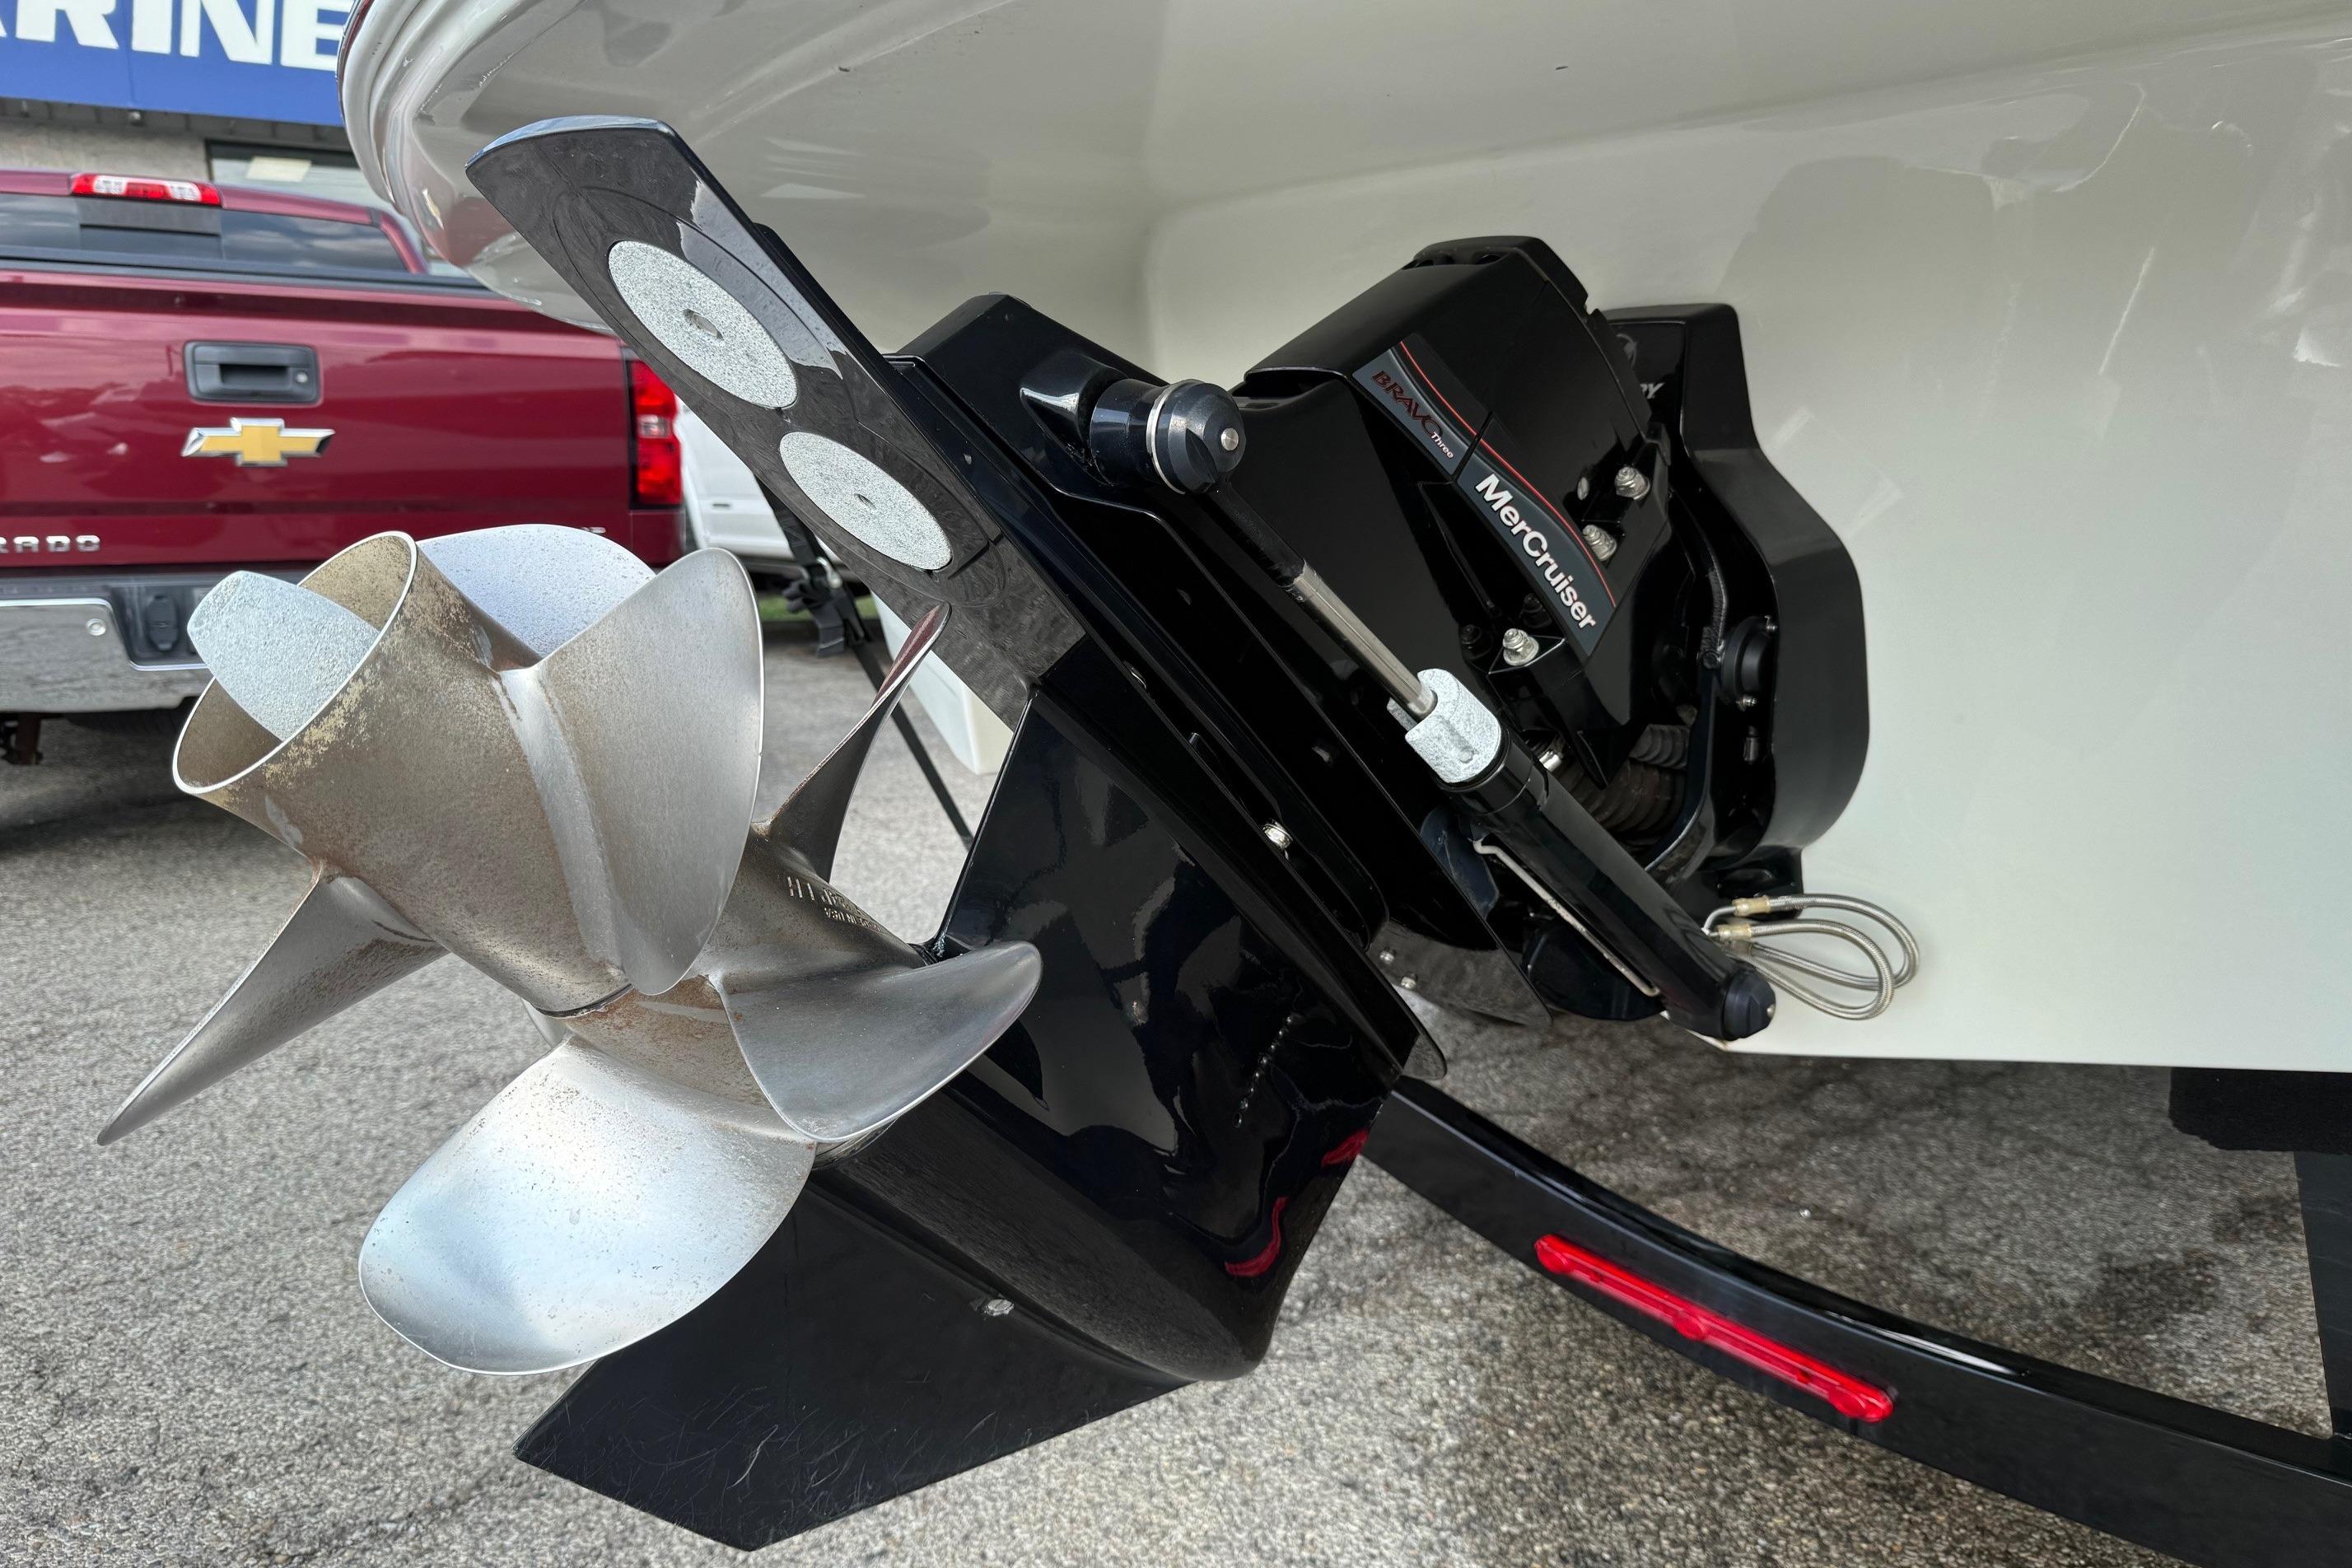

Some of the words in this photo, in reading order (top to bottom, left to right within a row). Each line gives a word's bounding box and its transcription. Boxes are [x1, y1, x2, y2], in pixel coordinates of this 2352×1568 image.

[0, 0, 352, 72] RINE
[1371, 371, 1443, 437] BRAVO
[1430, 432, 1454, 460] Three
[1475, 474, 1596, 629] MerCruiser
